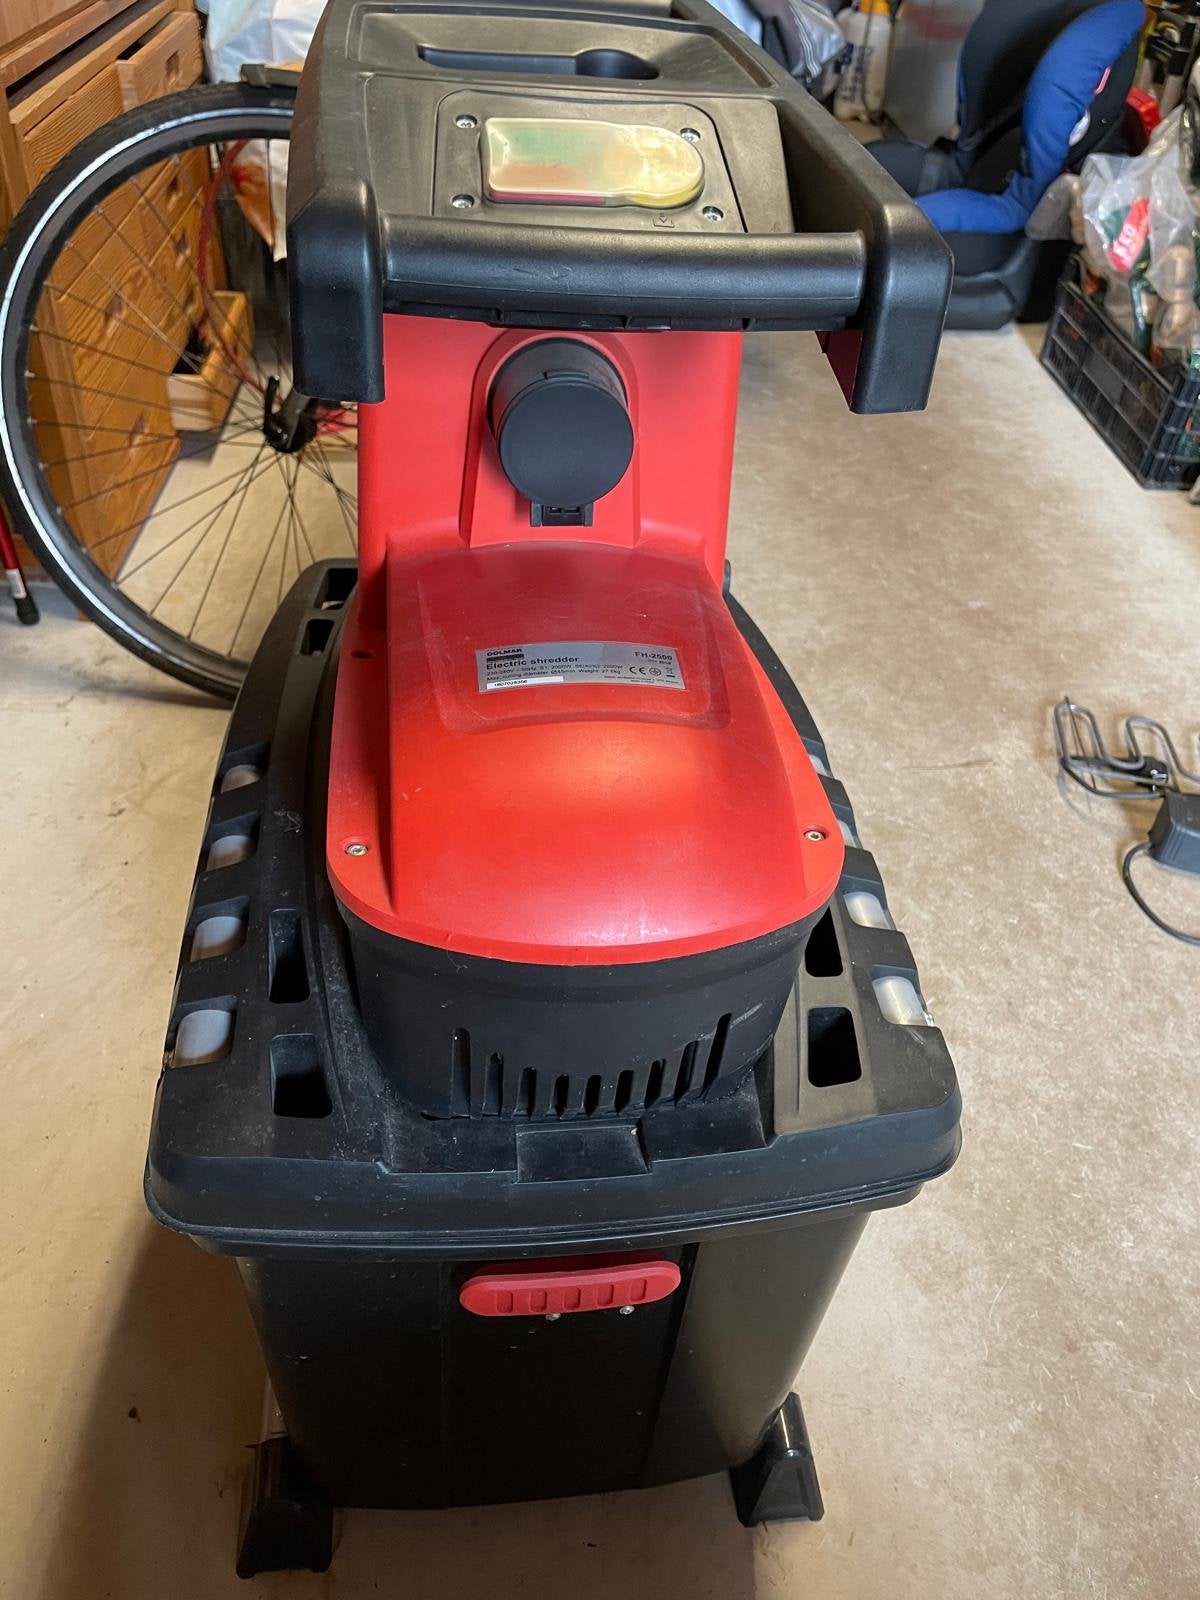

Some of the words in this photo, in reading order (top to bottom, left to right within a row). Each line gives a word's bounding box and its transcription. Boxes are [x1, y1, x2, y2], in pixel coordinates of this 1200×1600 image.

[486, 648, 523, 657] DOLMAR
[634, 651, 673, 661] FH-2500
[486, 660, 527, 670] Electric
[530, 656, 580, 665] shredder
